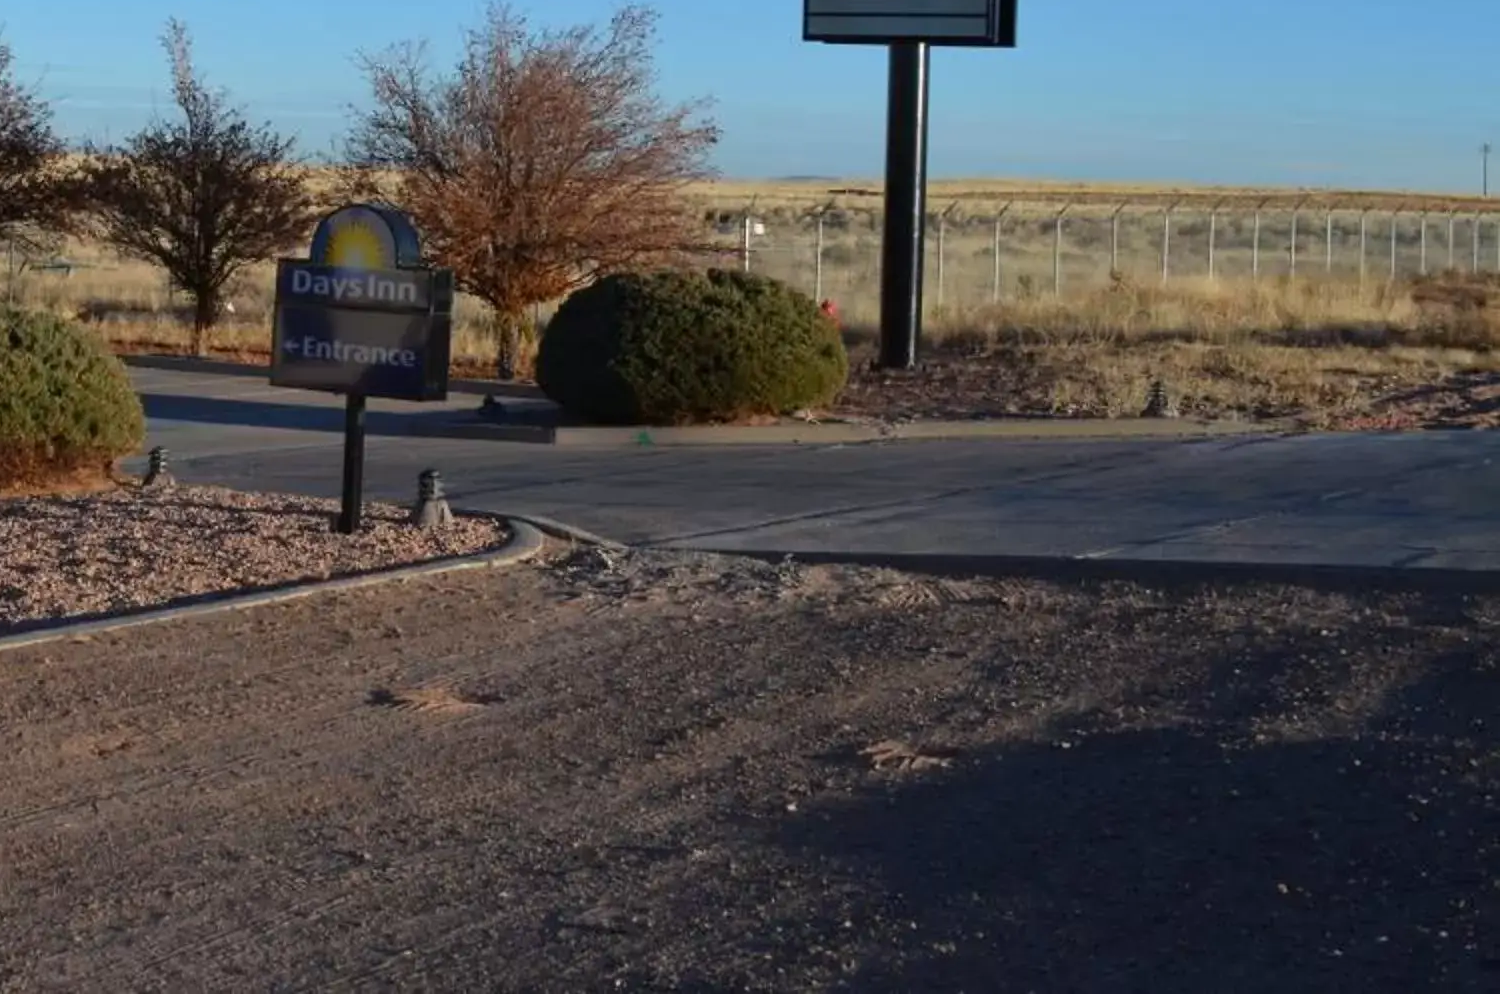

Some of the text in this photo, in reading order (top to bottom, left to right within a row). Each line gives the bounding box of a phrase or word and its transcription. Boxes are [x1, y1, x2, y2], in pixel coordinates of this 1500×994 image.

[291, 268, 418, 303] Days Inn
[302, 334, 417, 367] Entrance
